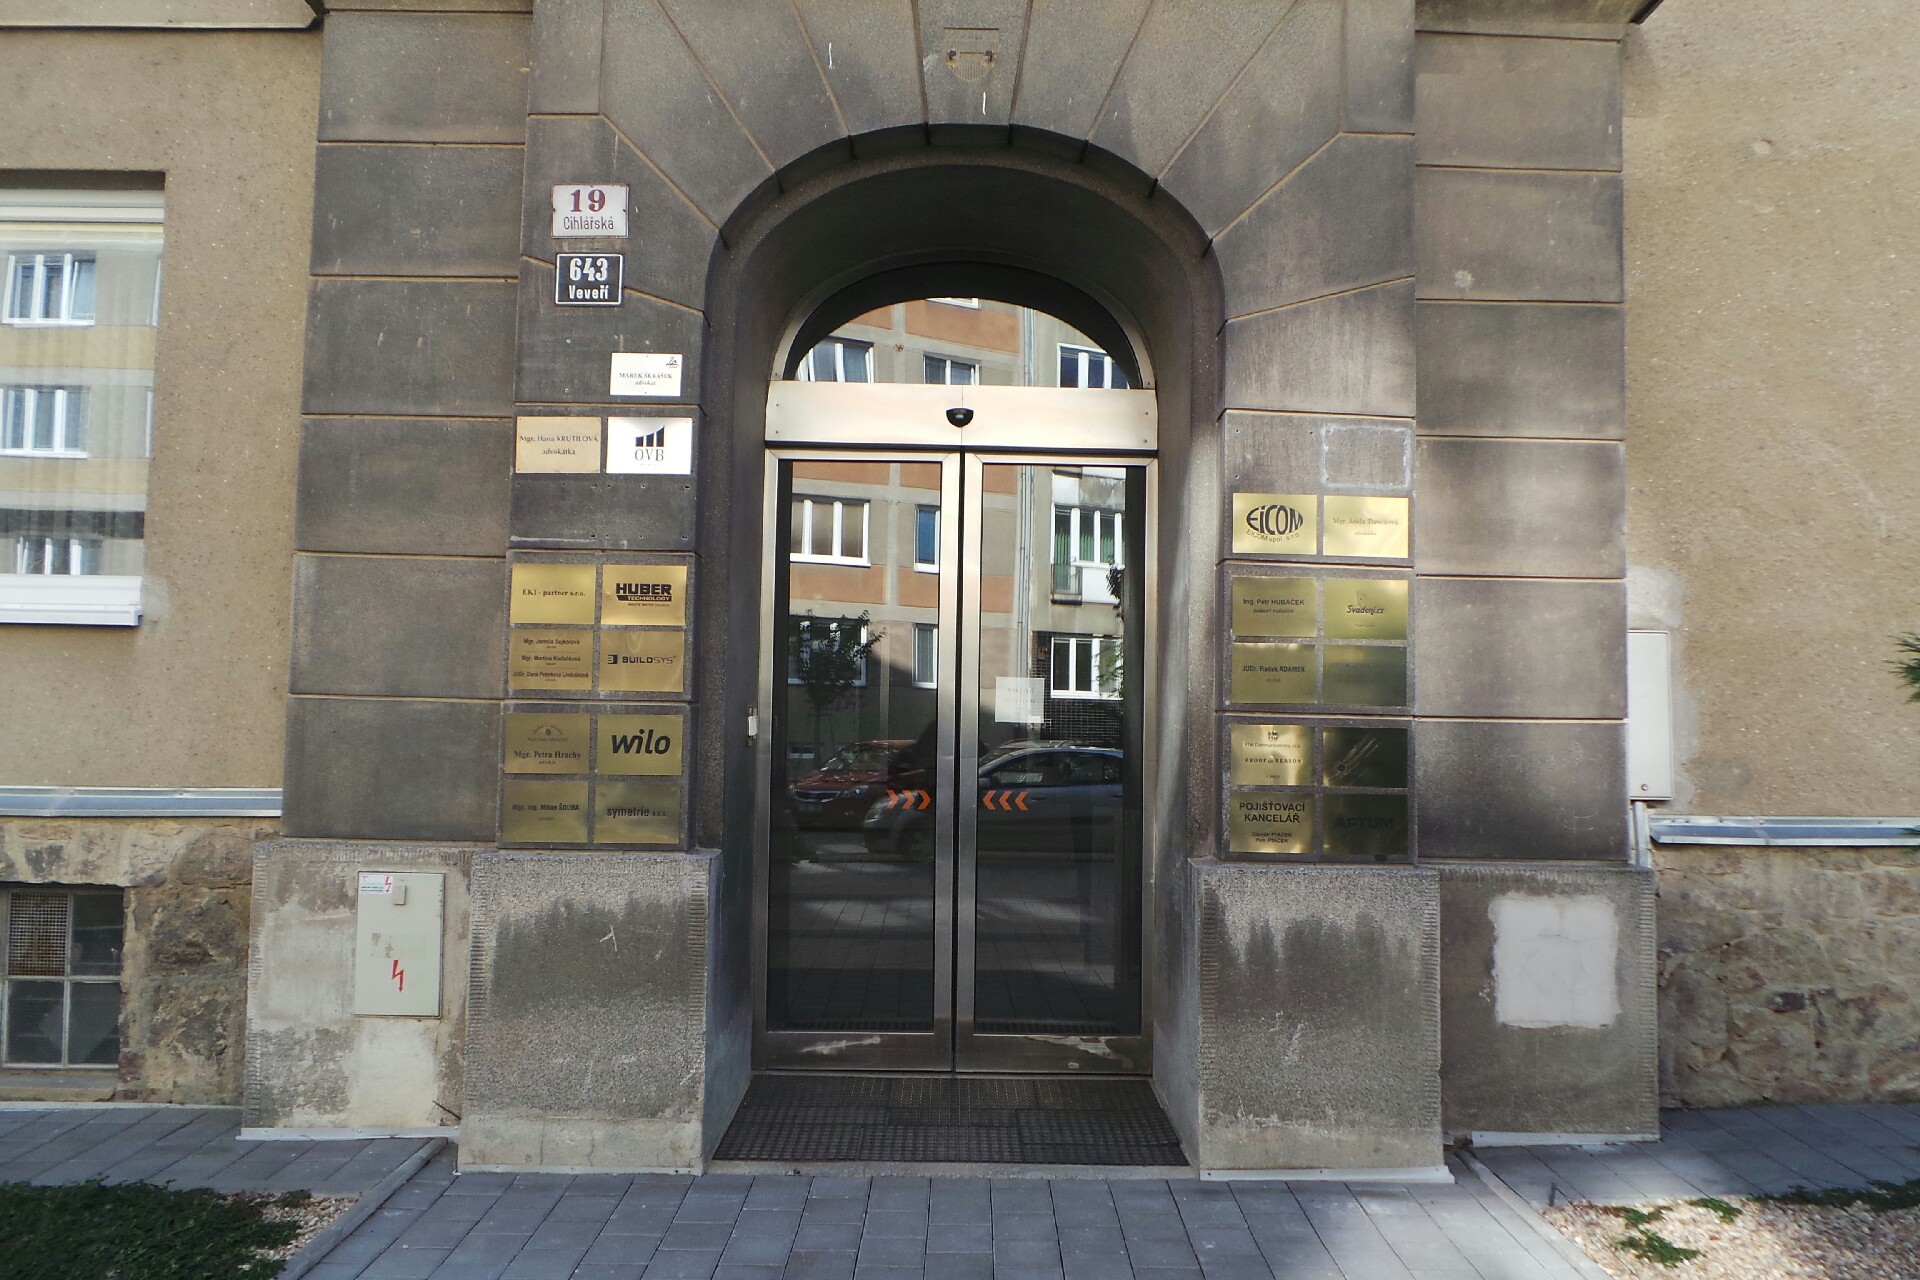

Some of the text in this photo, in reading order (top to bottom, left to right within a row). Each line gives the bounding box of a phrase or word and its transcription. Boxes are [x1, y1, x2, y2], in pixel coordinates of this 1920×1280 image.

[570, 189, 606, 213] 19
[563, 215, 614, 231] Cihlářská
[569, 257, 608, 282] 643
[568, 284, 609, 300] Veveří
[520, 435, 535, 444] Mgr.
[541, 447, 576, 455] advokátka
[634, 448, 665, 462] OVB
[543, 589, 568, 598] partner
[616, 583, 672, 595] HUBER
[523, 638, 535, 646] Mgr.
[521, 655, 533, 663] Mgr.
[622, 656, 673, 664] BUILDSYS
[611, 728, 671, 755] wilo
[514, 750, 531, 759] Mgr.
[534, 750, 553, 758] Petra
[607, 806, 650, 819] symetrie
[1239, 801, 1305, 812] POJIŠŤOVACÍ
[1244, 812, 1300, 824] KANCELÁŘ
